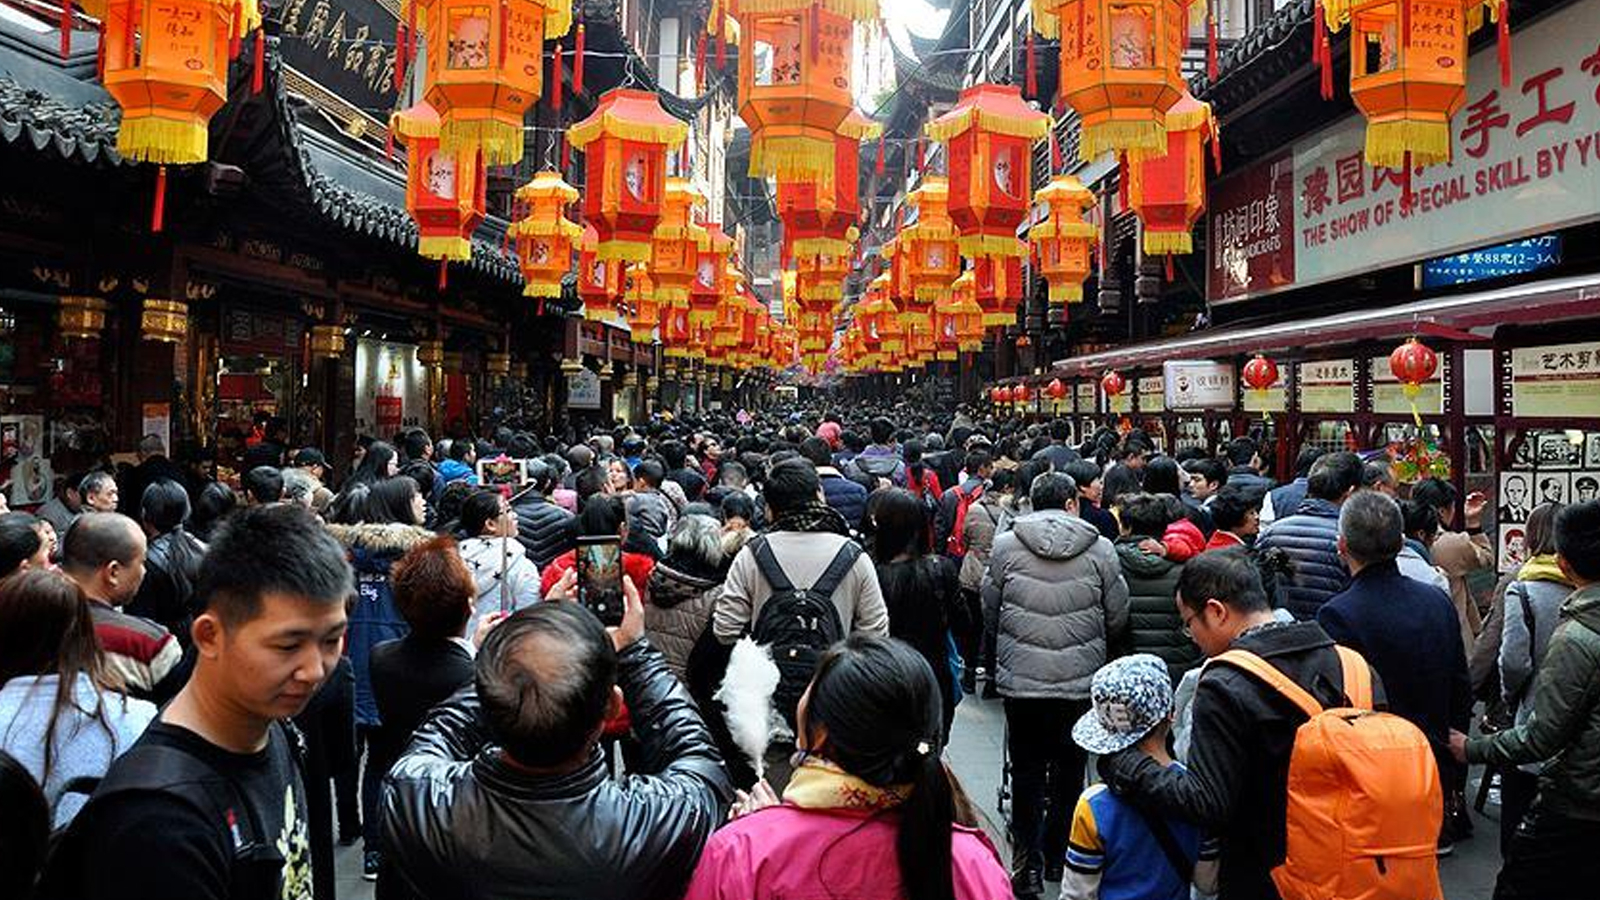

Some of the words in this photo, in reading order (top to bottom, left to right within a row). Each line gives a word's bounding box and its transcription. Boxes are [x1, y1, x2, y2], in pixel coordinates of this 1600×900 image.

[1302, 218, 1328, 249] THE
[1330, 206, 1370, 238] SHOW
[1374, 199, 1394, 227] OF
[1475, 155, 1531, 196] SKILL
[1536, 142, 1568, 179] BY
[1541, 350, 1600, 371] 艺术剪
